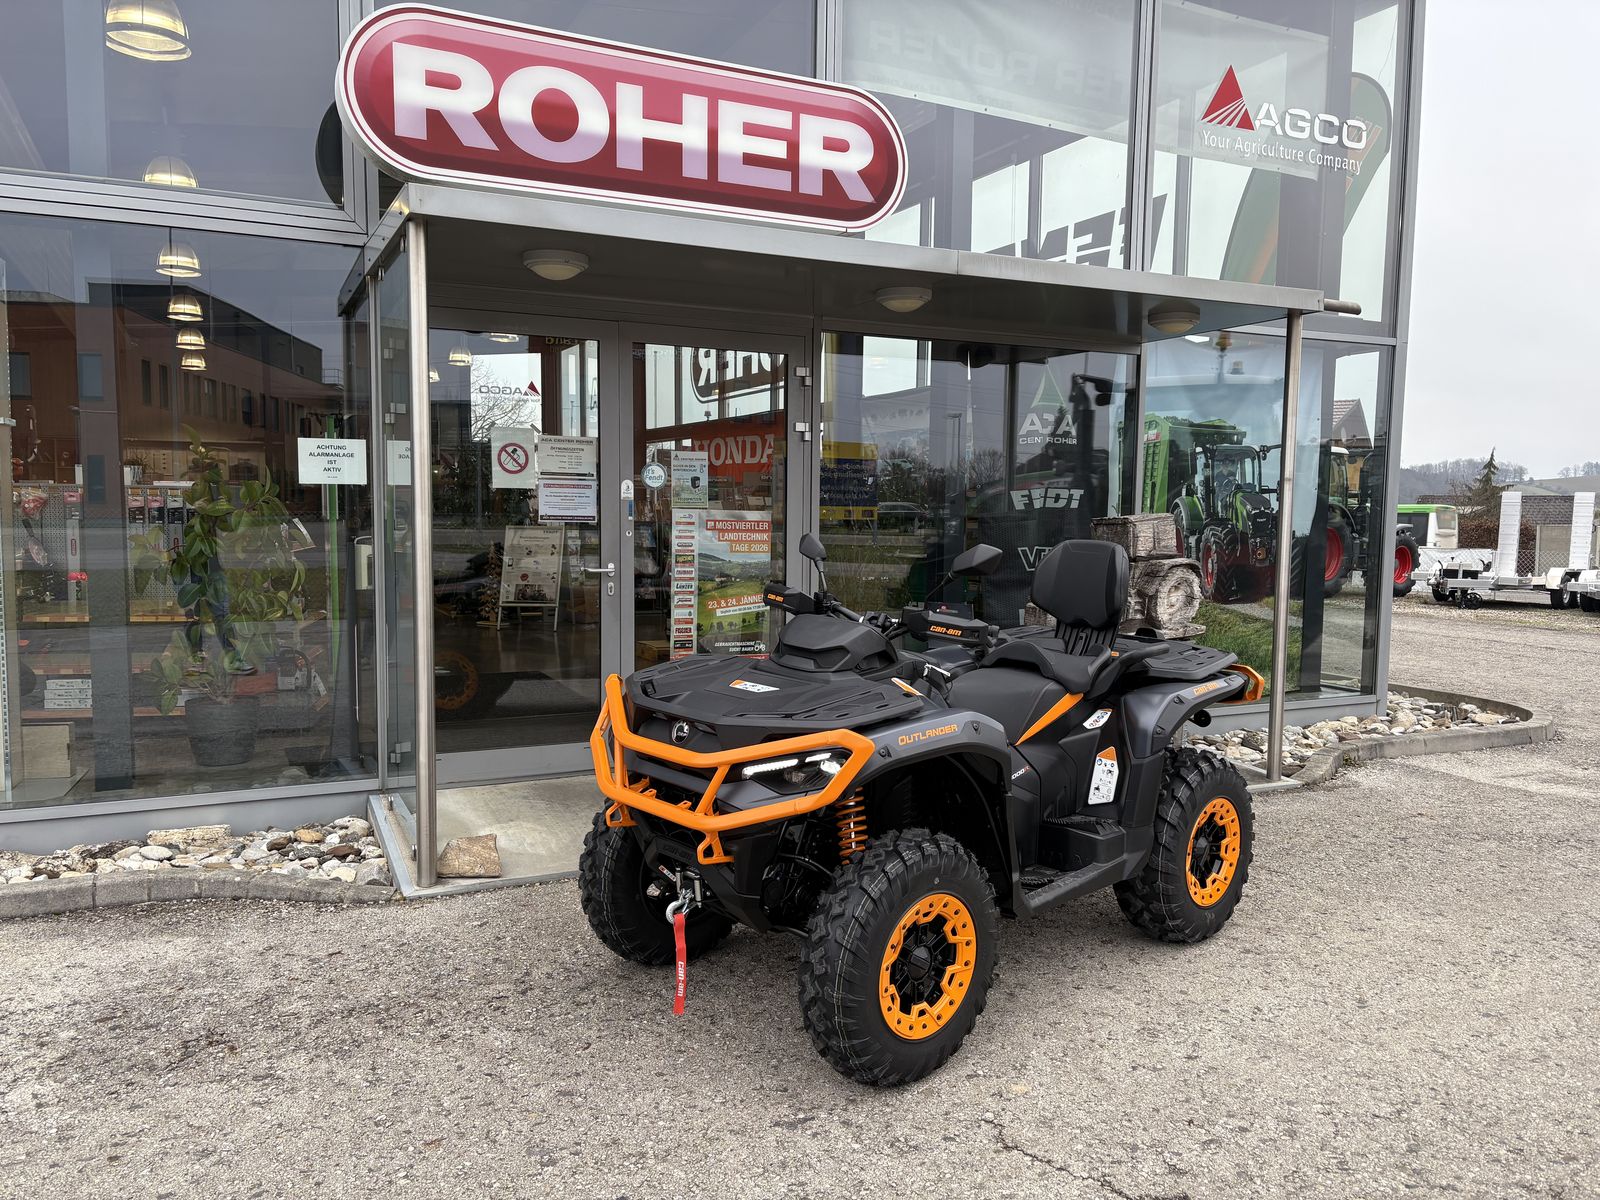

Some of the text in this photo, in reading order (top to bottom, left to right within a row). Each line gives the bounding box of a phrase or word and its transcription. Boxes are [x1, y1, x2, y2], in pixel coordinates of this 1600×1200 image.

[392, 41, 877, 204] ROHER
[1255, 102, 1367, 150] AGCO
[1202, 129, 1362, 175] Your Agriculture Company
[715, 521, 769, 530] MOSTVIERTLER
[719, 532, 769, 541] LANDTECHNIK
[731, 543, 769, 552] TAGE 2026
[708, 600, 720, 609] 23.
[727, 598, 739, 606] 24.
[898, 723, 958, 746] OUTLANDER
[677, 960, 685, 997] can-am
